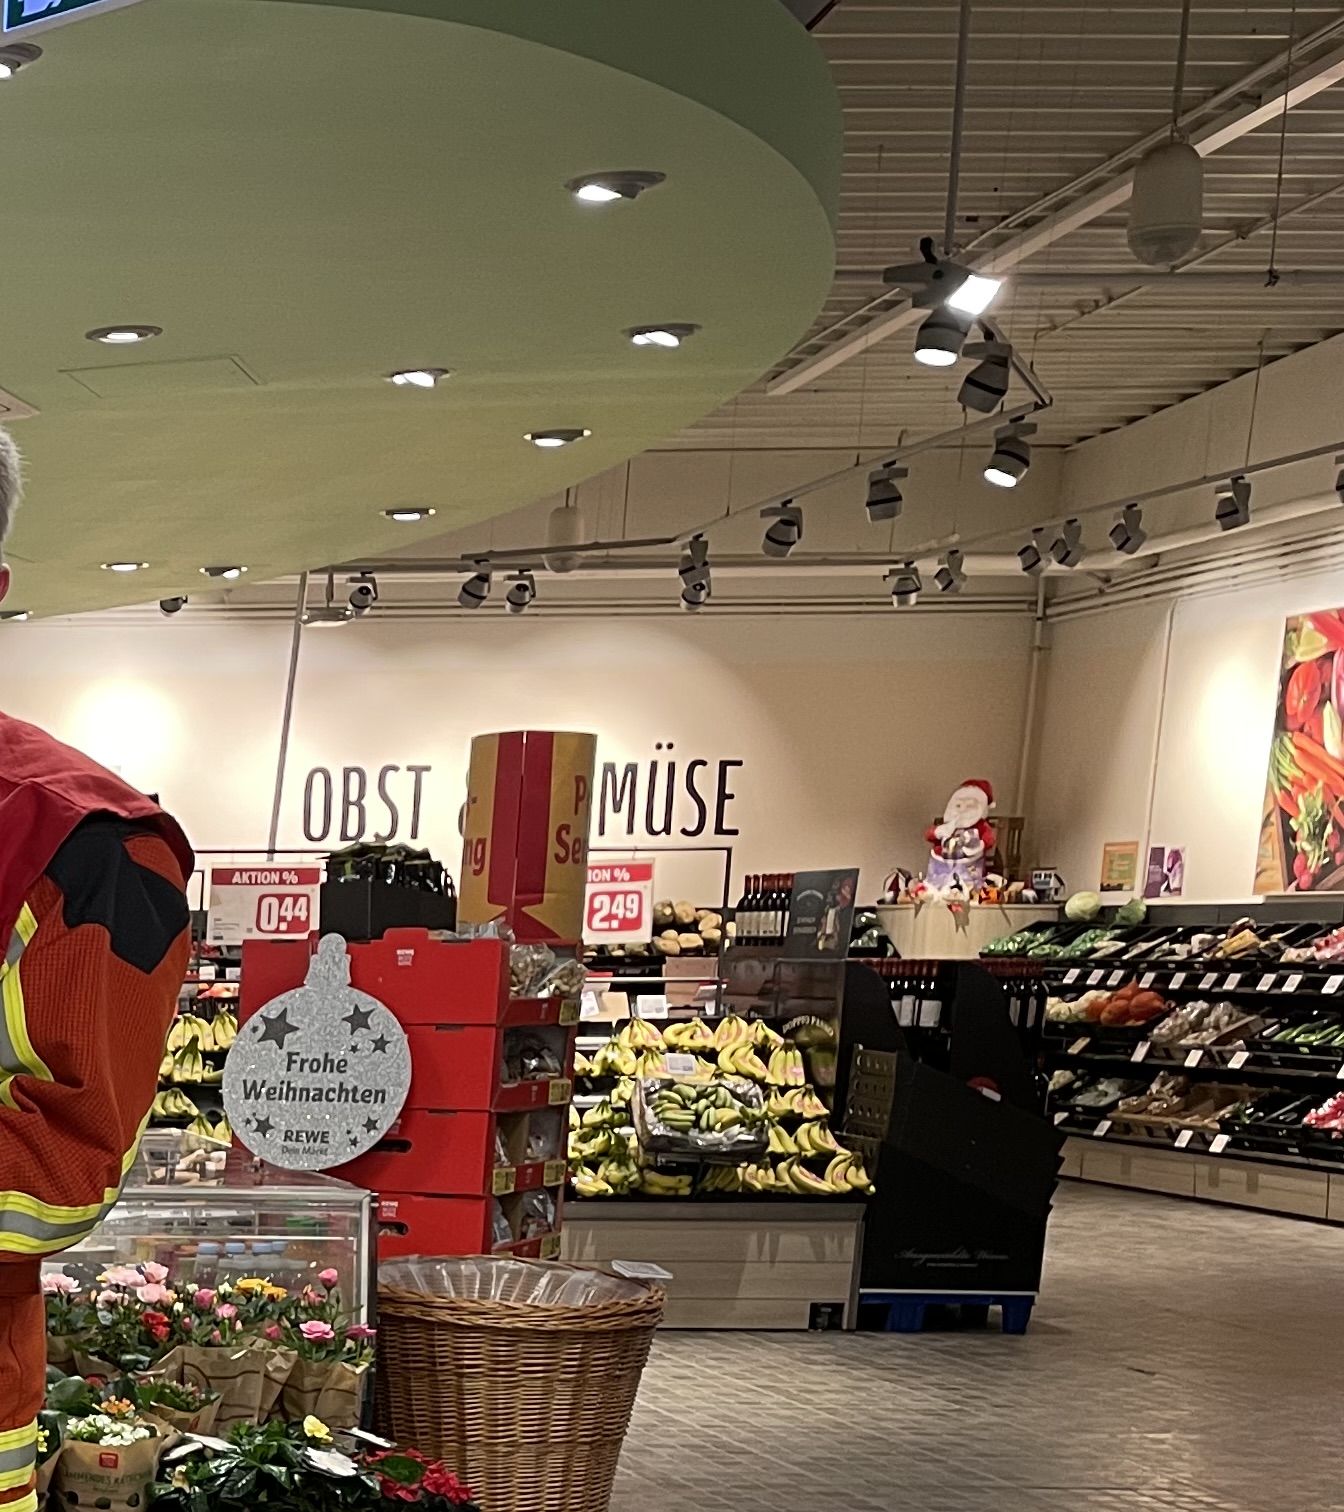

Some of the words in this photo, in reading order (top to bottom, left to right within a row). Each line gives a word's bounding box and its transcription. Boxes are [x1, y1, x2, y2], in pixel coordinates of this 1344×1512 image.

[303, 764, 432, 842] OBST
[598, 742, 744, 837] MÜSE
[231, 871, 280, 885] AKTION
[282, 870, 299, 885] %
[587, 868, 611, 882] ION
[614, 868, 630, 882] %
[260, 896, 308, 932] 0.44
[591, 893, 640, 930] 2.49
[286, 1051, 349, 1074] Frohe
[242, 1079, 387, 1105] Weihnachten
[283, 1129, 330, 1144] REWE
